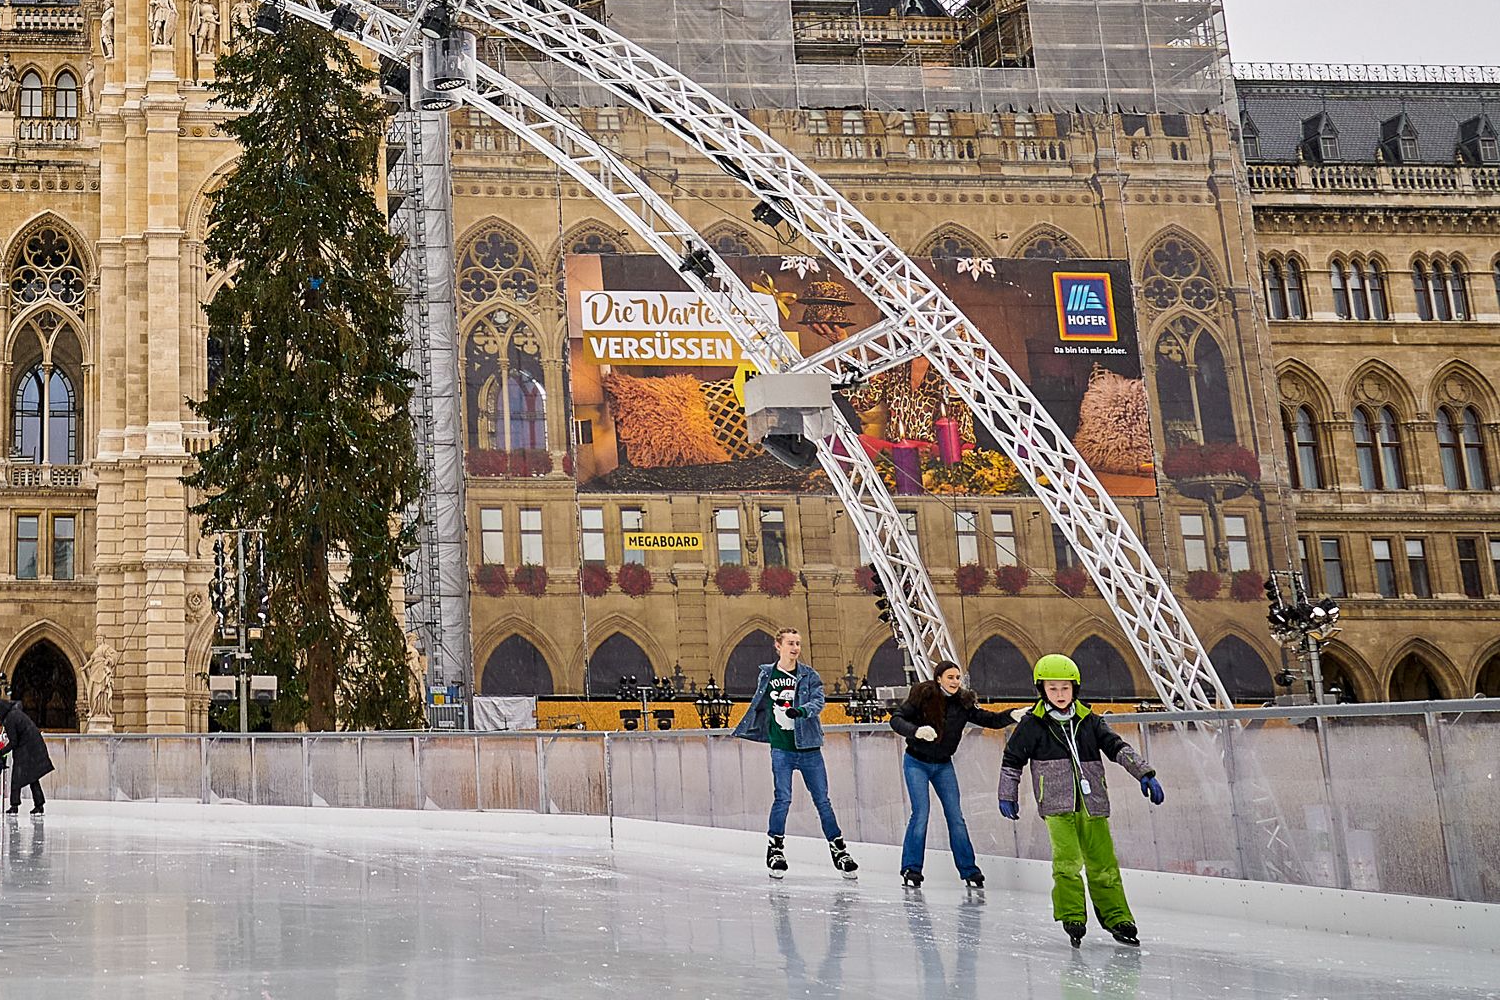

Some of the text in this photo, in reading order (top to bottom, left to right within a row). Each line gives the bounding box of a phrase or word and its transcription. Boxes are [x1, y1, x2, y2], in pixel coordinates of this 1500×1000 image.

[585, 293, 636, 325] Die
[1067, 314, 1107, 326] HOFER
[589, 331, 733, 360] VERSÜSSEN
[1054, 346, 1127, 355] Da bin ich mir sicher.
[628, 535, 699, 548] MEGABOARD
